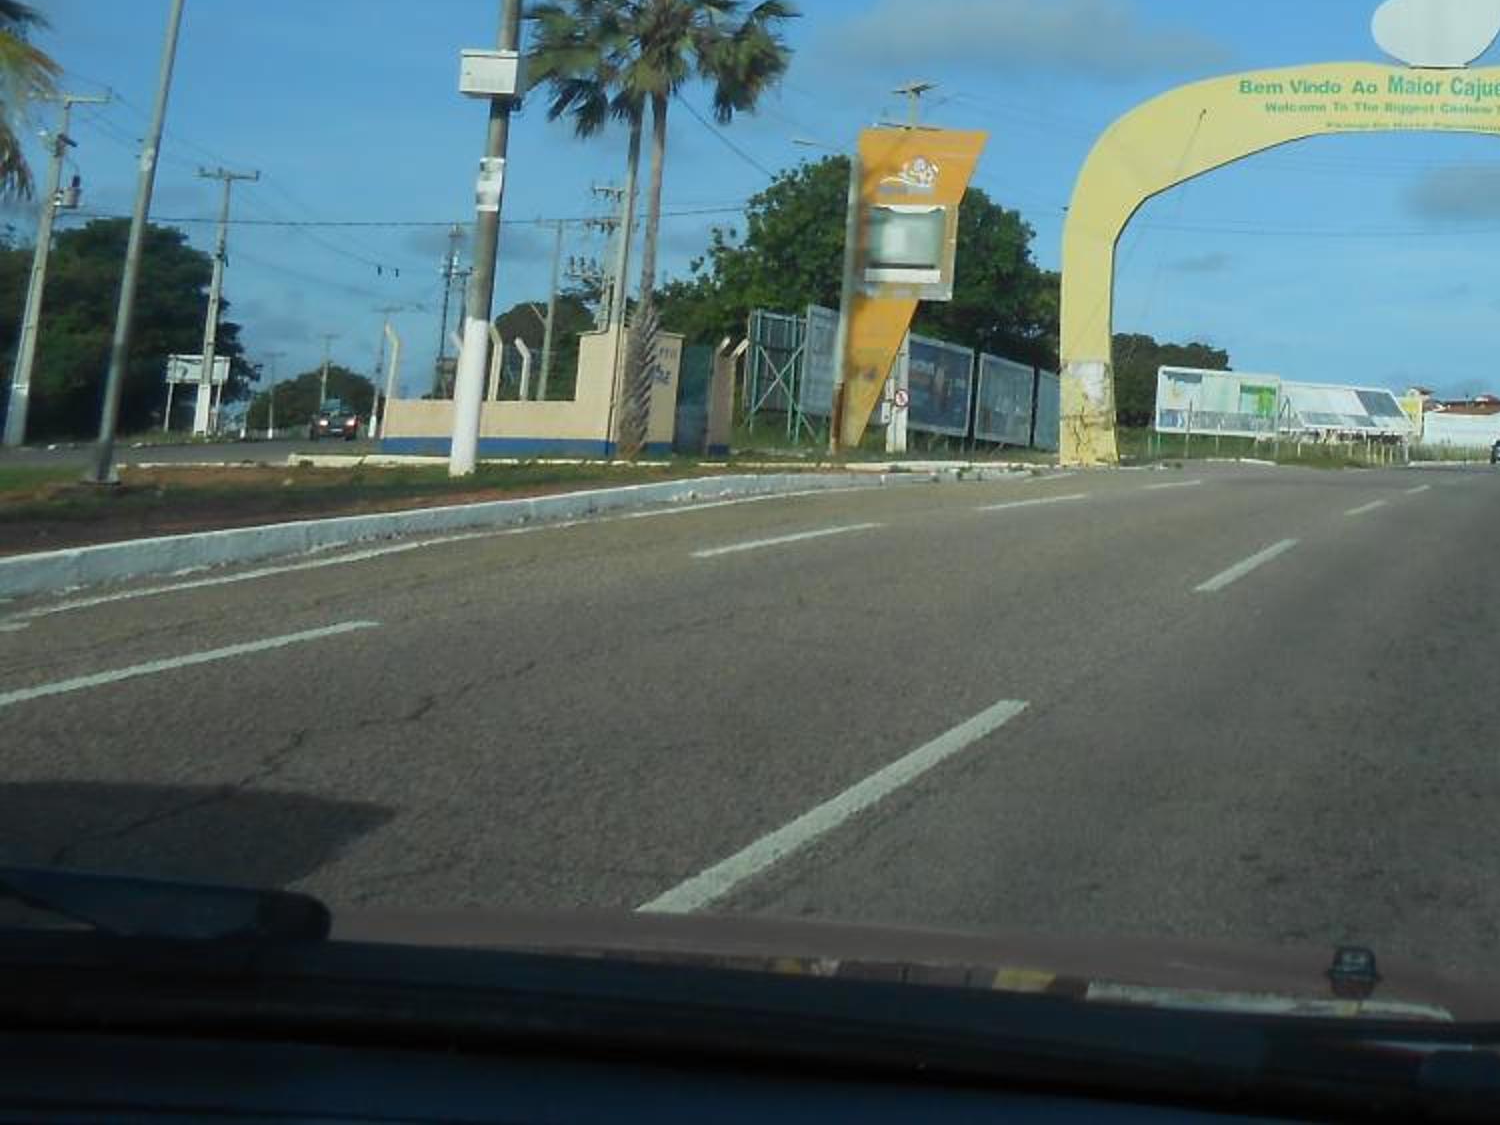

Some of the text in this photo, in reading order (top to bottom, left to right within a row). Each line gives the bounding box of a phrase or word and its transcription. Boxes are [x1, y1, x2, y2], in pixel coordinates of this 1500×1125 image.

[1239, 80, 1284, 94] Bem
[1290, 79, 1341, 94] Vindo
[1352, 80, 1377, 94] Ao
[1388, 75, 1441, 95] Maior
[1265, 102, 1327, 112] Welcome
[1333, 102, 1348, 112] To
[1354, 102, 1379, 112] The
